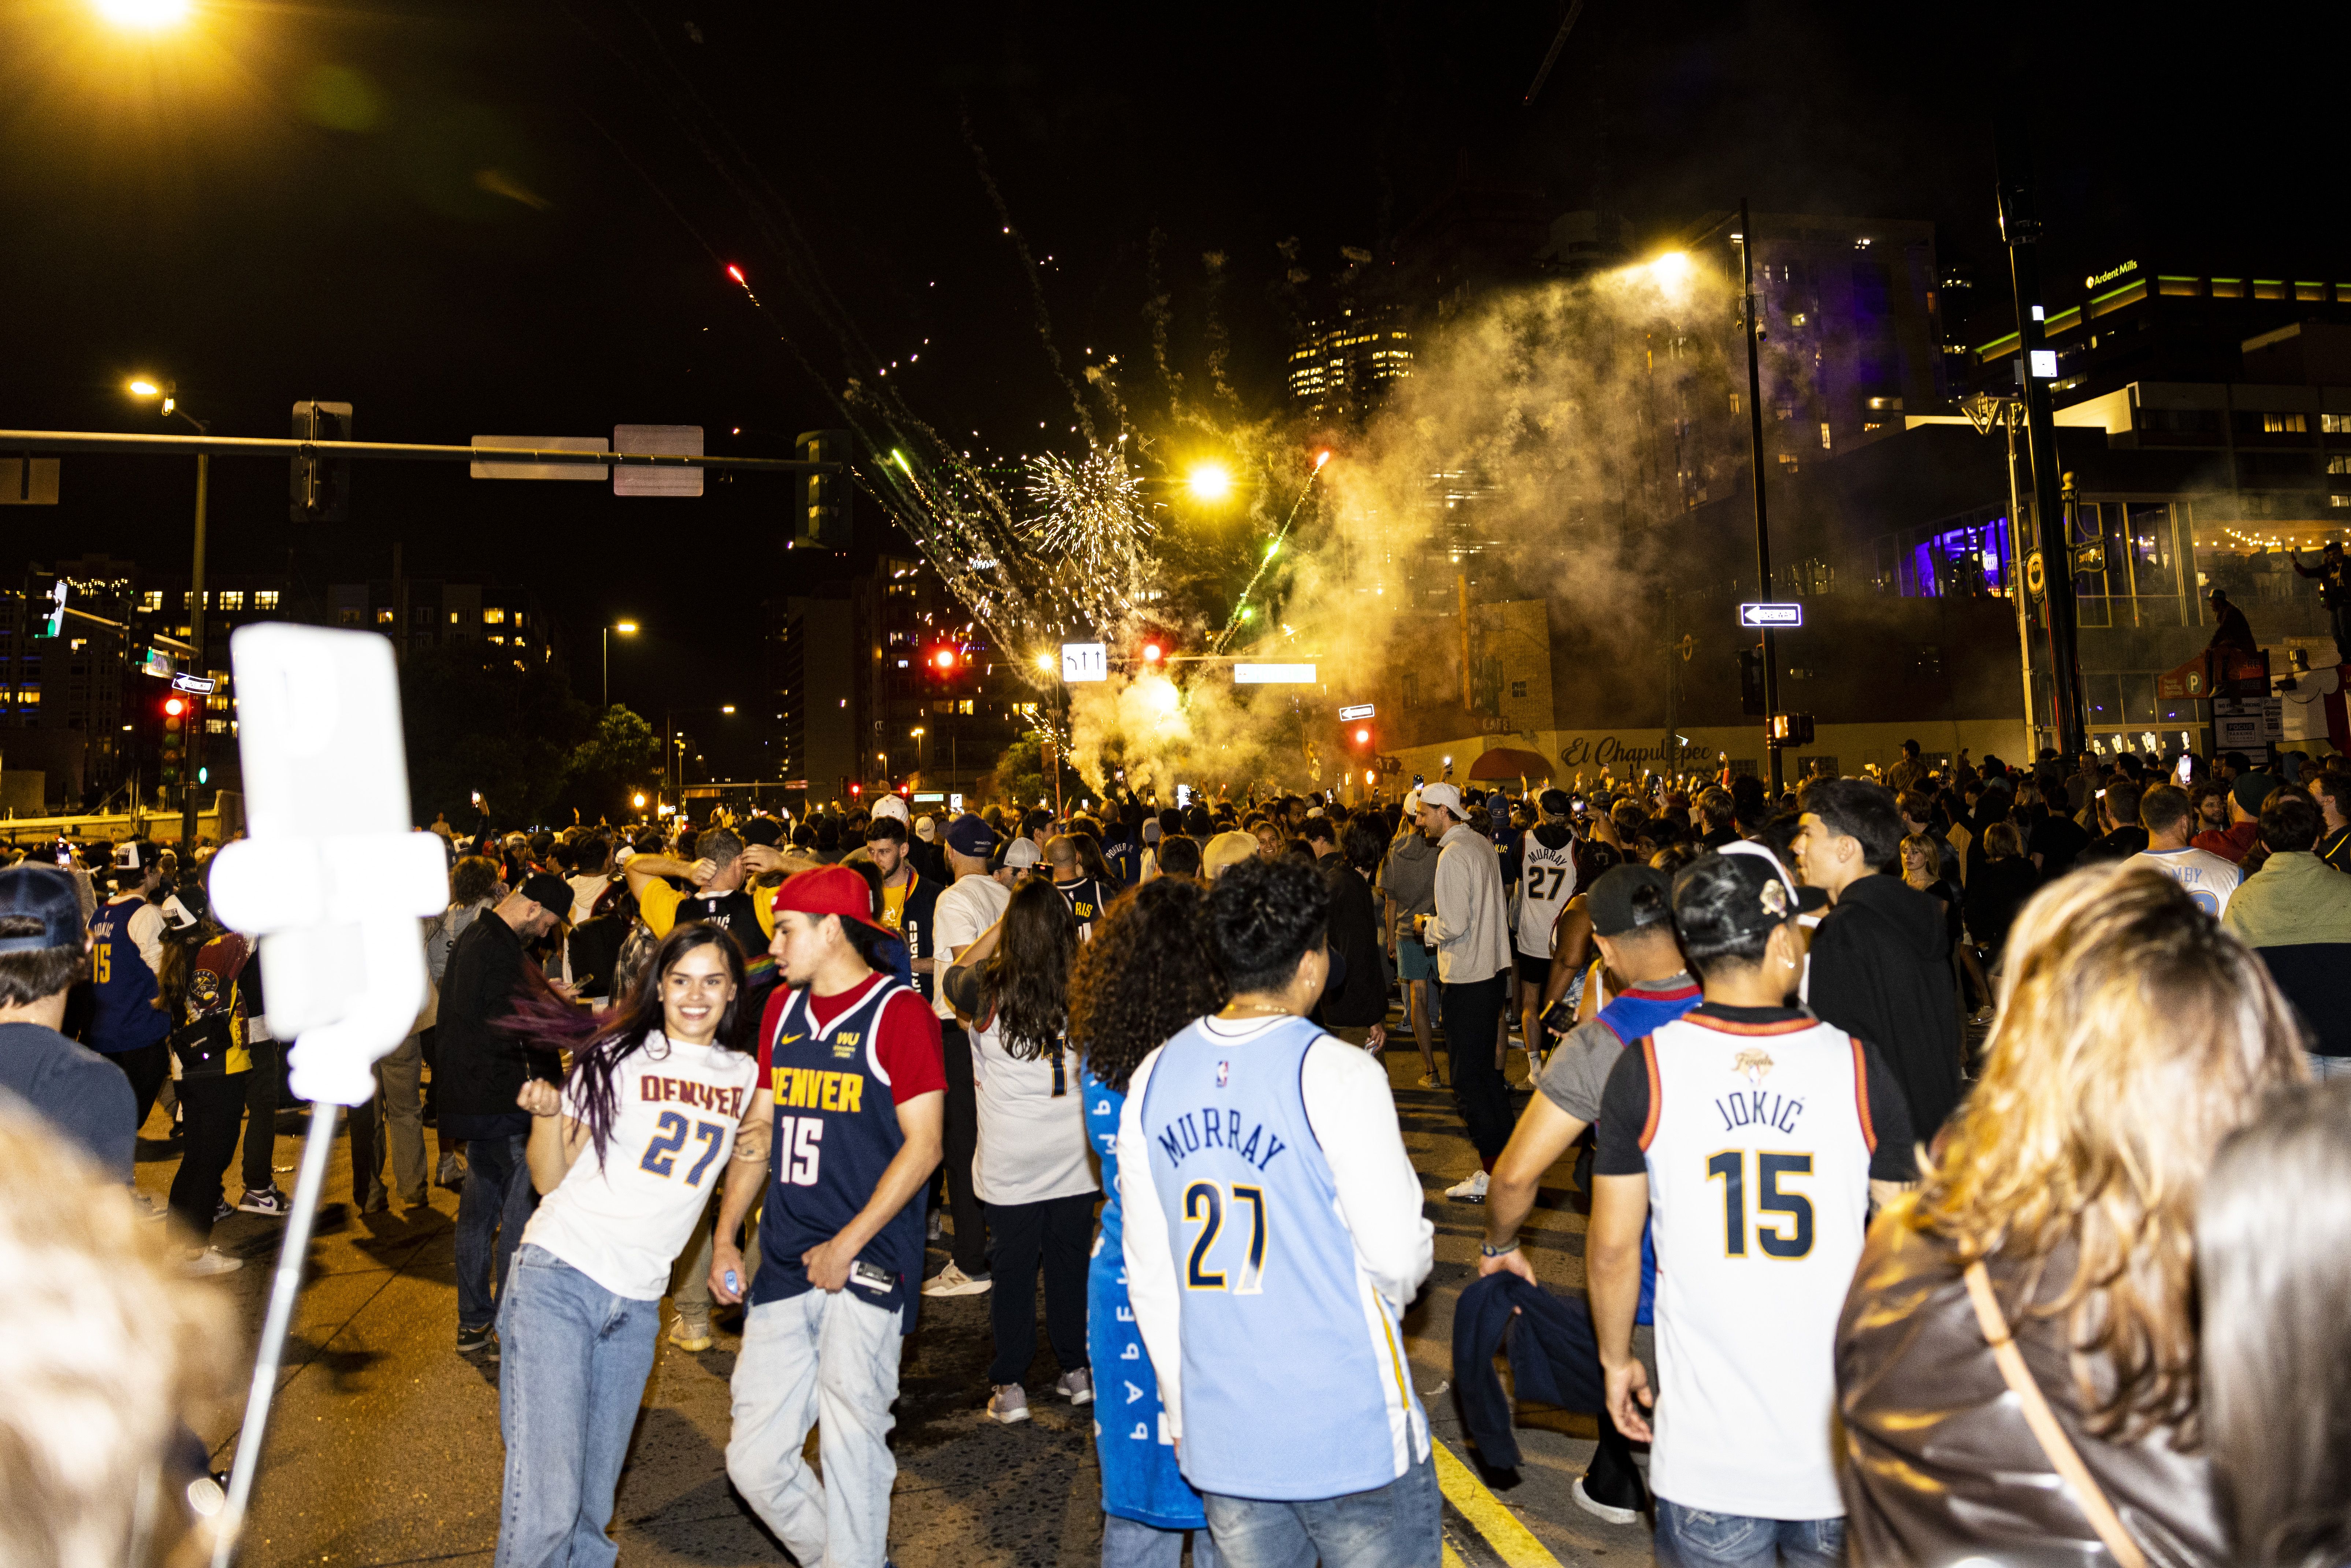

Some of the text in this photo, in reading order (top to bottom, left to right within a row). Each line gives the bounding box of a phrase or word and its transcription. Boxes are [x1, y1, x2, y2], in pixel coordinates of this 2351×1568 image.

[2094, 259, 2138, 286] Ardent Mills
[2190, 675, 2198, 691] P
[1561, 736, 1713, 769] El Chapulepec
[1106, 843, 1126, 859] PORTER
[1495, 844, 1508, 853] KIĆ
[1528, 848, 1567, 866] MURRAY
[1120, 857, 1126, 879] 1
[1528, 865, 1567, 901] 27
[1075, 902, 1093, 918] RIS
[93, 943, 111, 984] 15
[190, 1036, 208, 1048] Supreme
[836, 1031, 860, 1046] WU
[641, 1074, 744, 1120] DENVER
[1715, 1090, 1805, 1134] JOKIĆ
[638, 1109, 726, 1188] 27
[780, 1114, 824, 1186] 15
[1158, 1107, 1286, 1172] MURRAY
[1705, 1148, 1816, 1262] 15
[1181, 1177, 1269, 1295] 27
